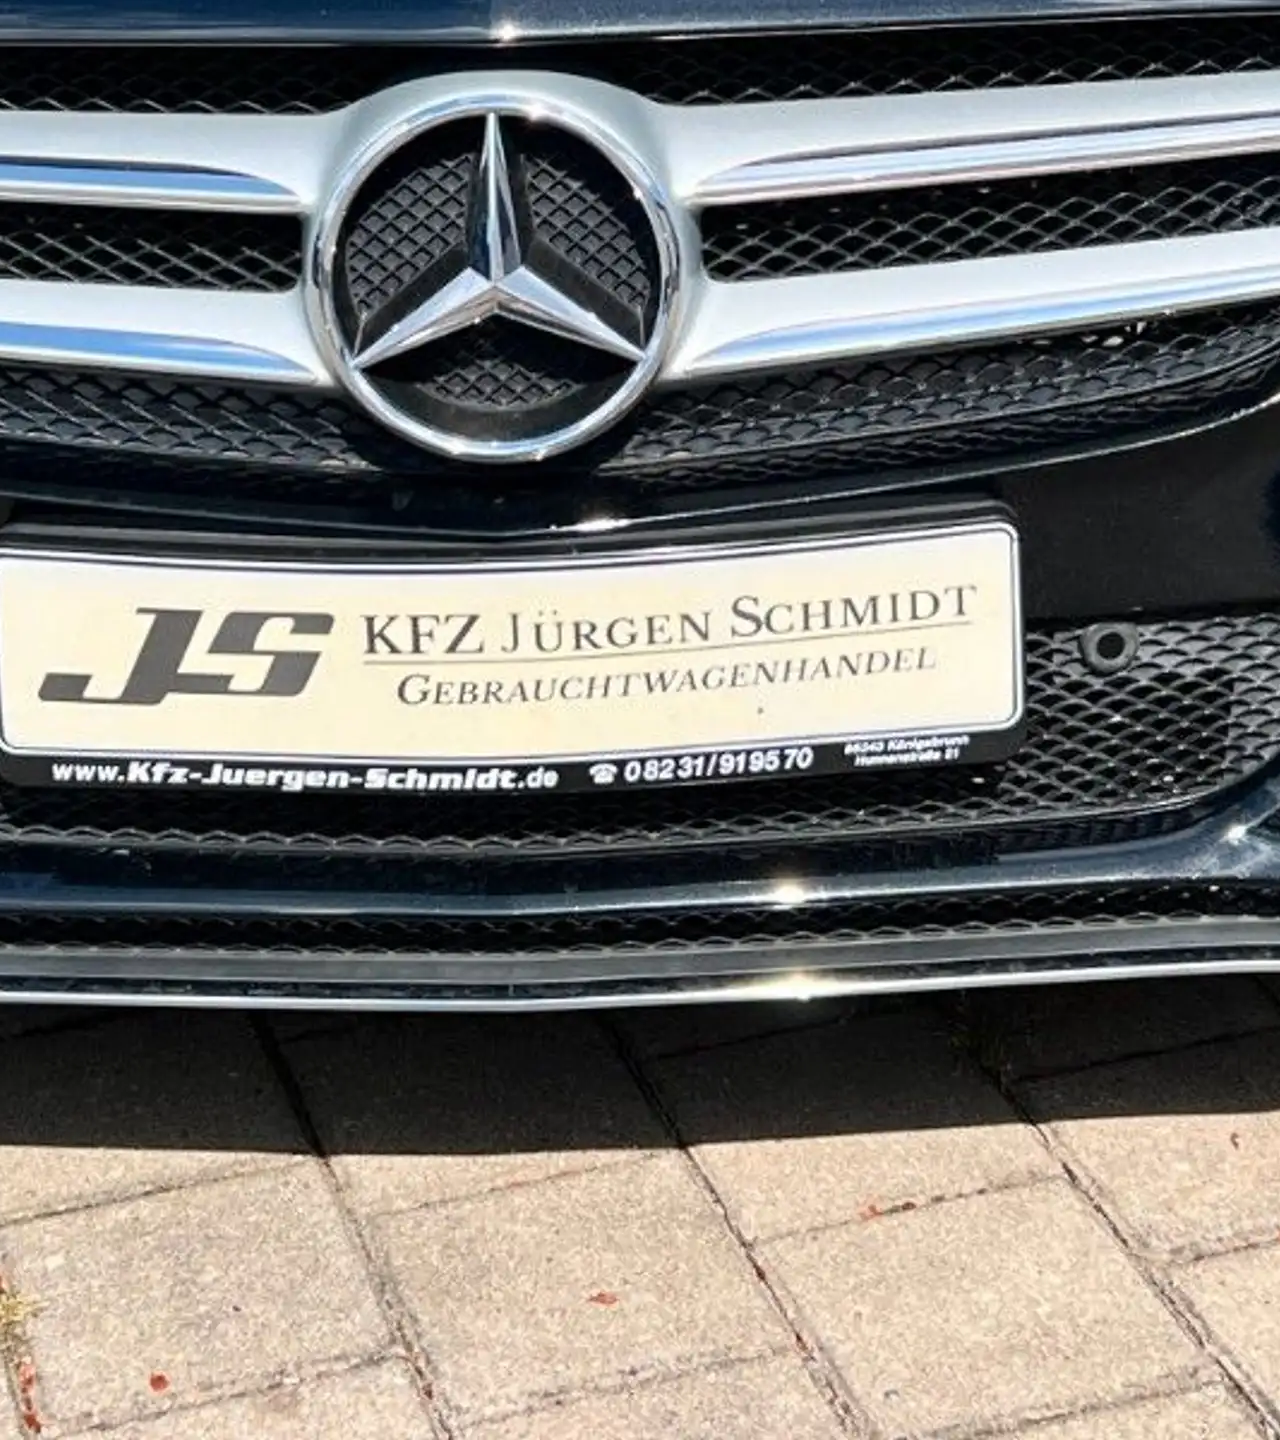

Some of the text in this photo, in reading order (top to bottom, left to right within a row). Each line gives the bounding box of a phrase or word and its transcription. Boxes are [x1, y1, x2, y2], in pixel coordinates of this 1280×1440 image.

[361, 584, 978, 655] KFZ JÜRGEN SCHMIDT
[37, 606, 335, 706] JS
[396, 646, 939, 707] GEBRAUCHTWAGENHANDEL
[51, 745, 815, 792] www.Kfz-Juergen-Schmidt.de 08231/919570
